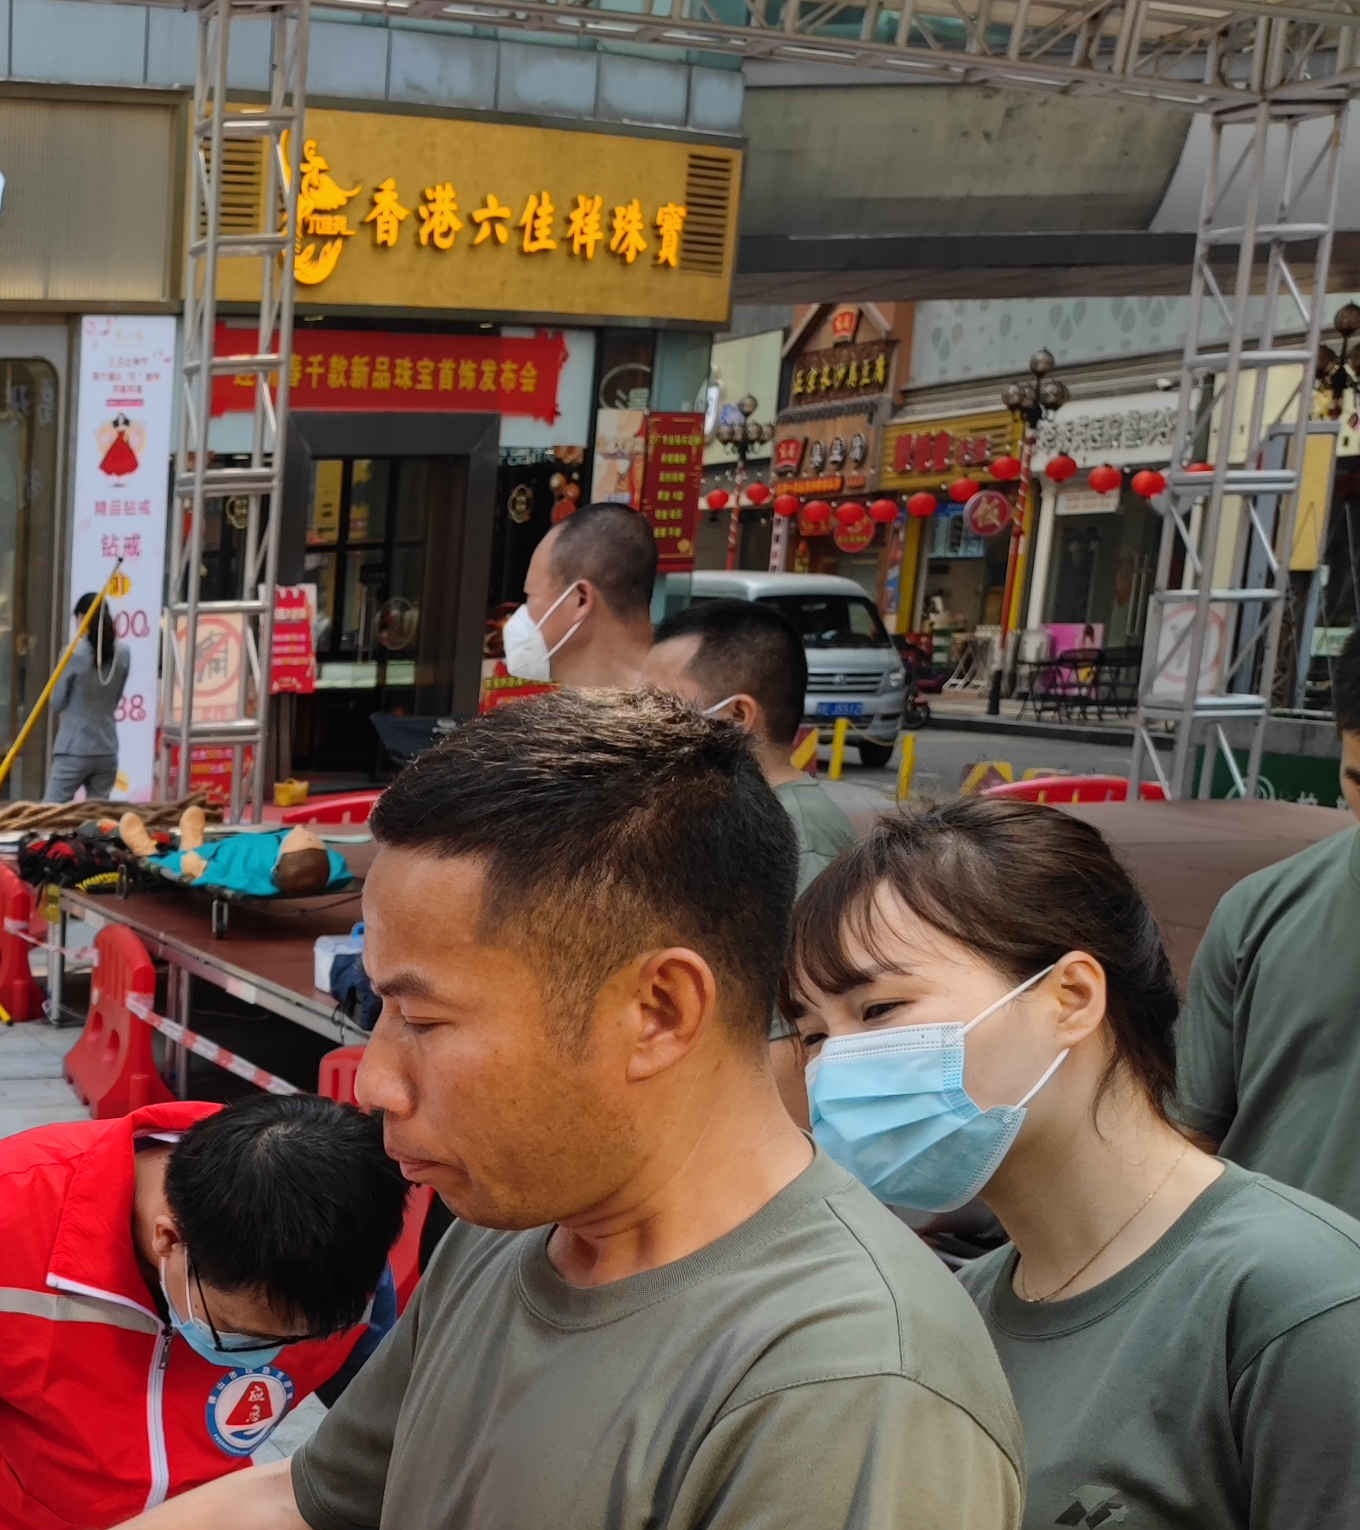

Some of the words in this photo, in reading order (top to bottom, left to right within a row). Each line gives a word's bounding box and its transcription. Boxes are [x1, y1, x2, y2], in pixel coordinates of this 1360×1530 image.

[367, 177, 687, 268] 香港六佳祥珠寶
